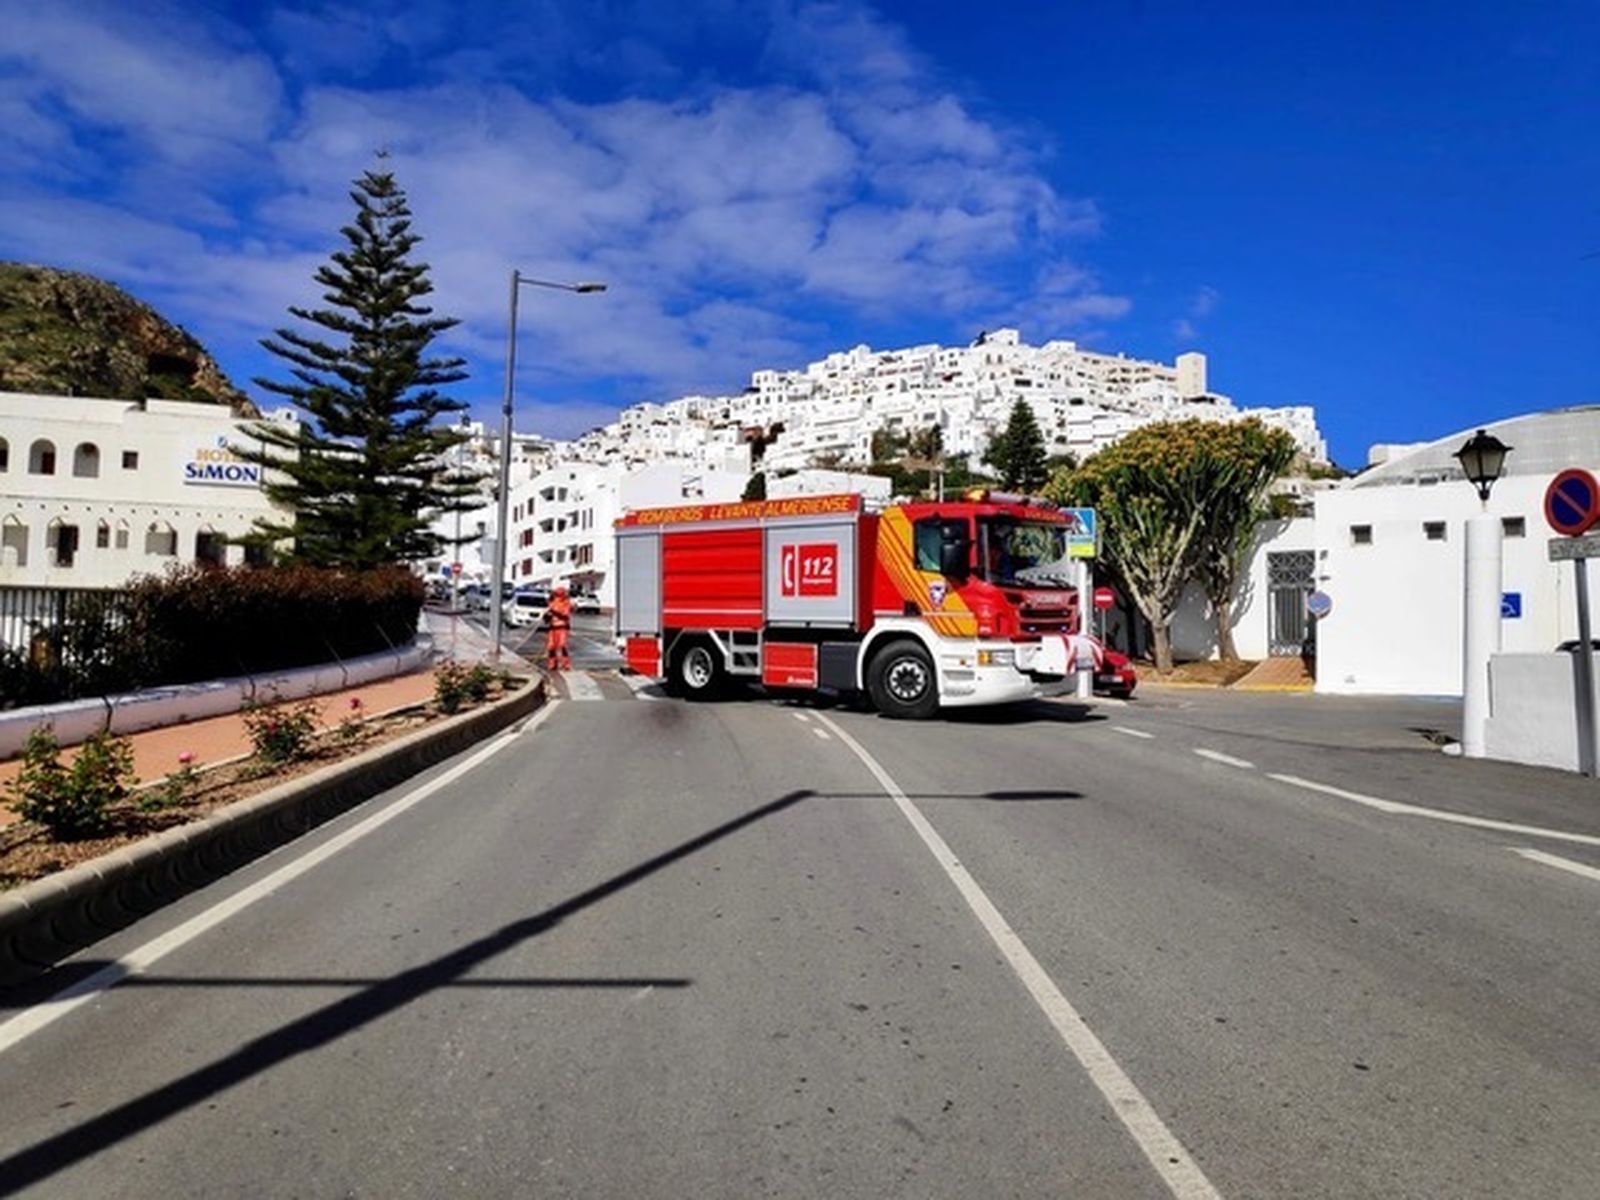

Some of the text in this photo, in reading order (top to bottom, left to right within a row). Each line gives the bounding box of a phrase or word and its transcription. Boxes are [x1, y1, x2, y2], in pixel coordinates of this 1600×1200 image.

[638, 497, 849, 525] BOMBEROS LEVANTE ALMERIENSE
[802, 556, 833, 576] 112
